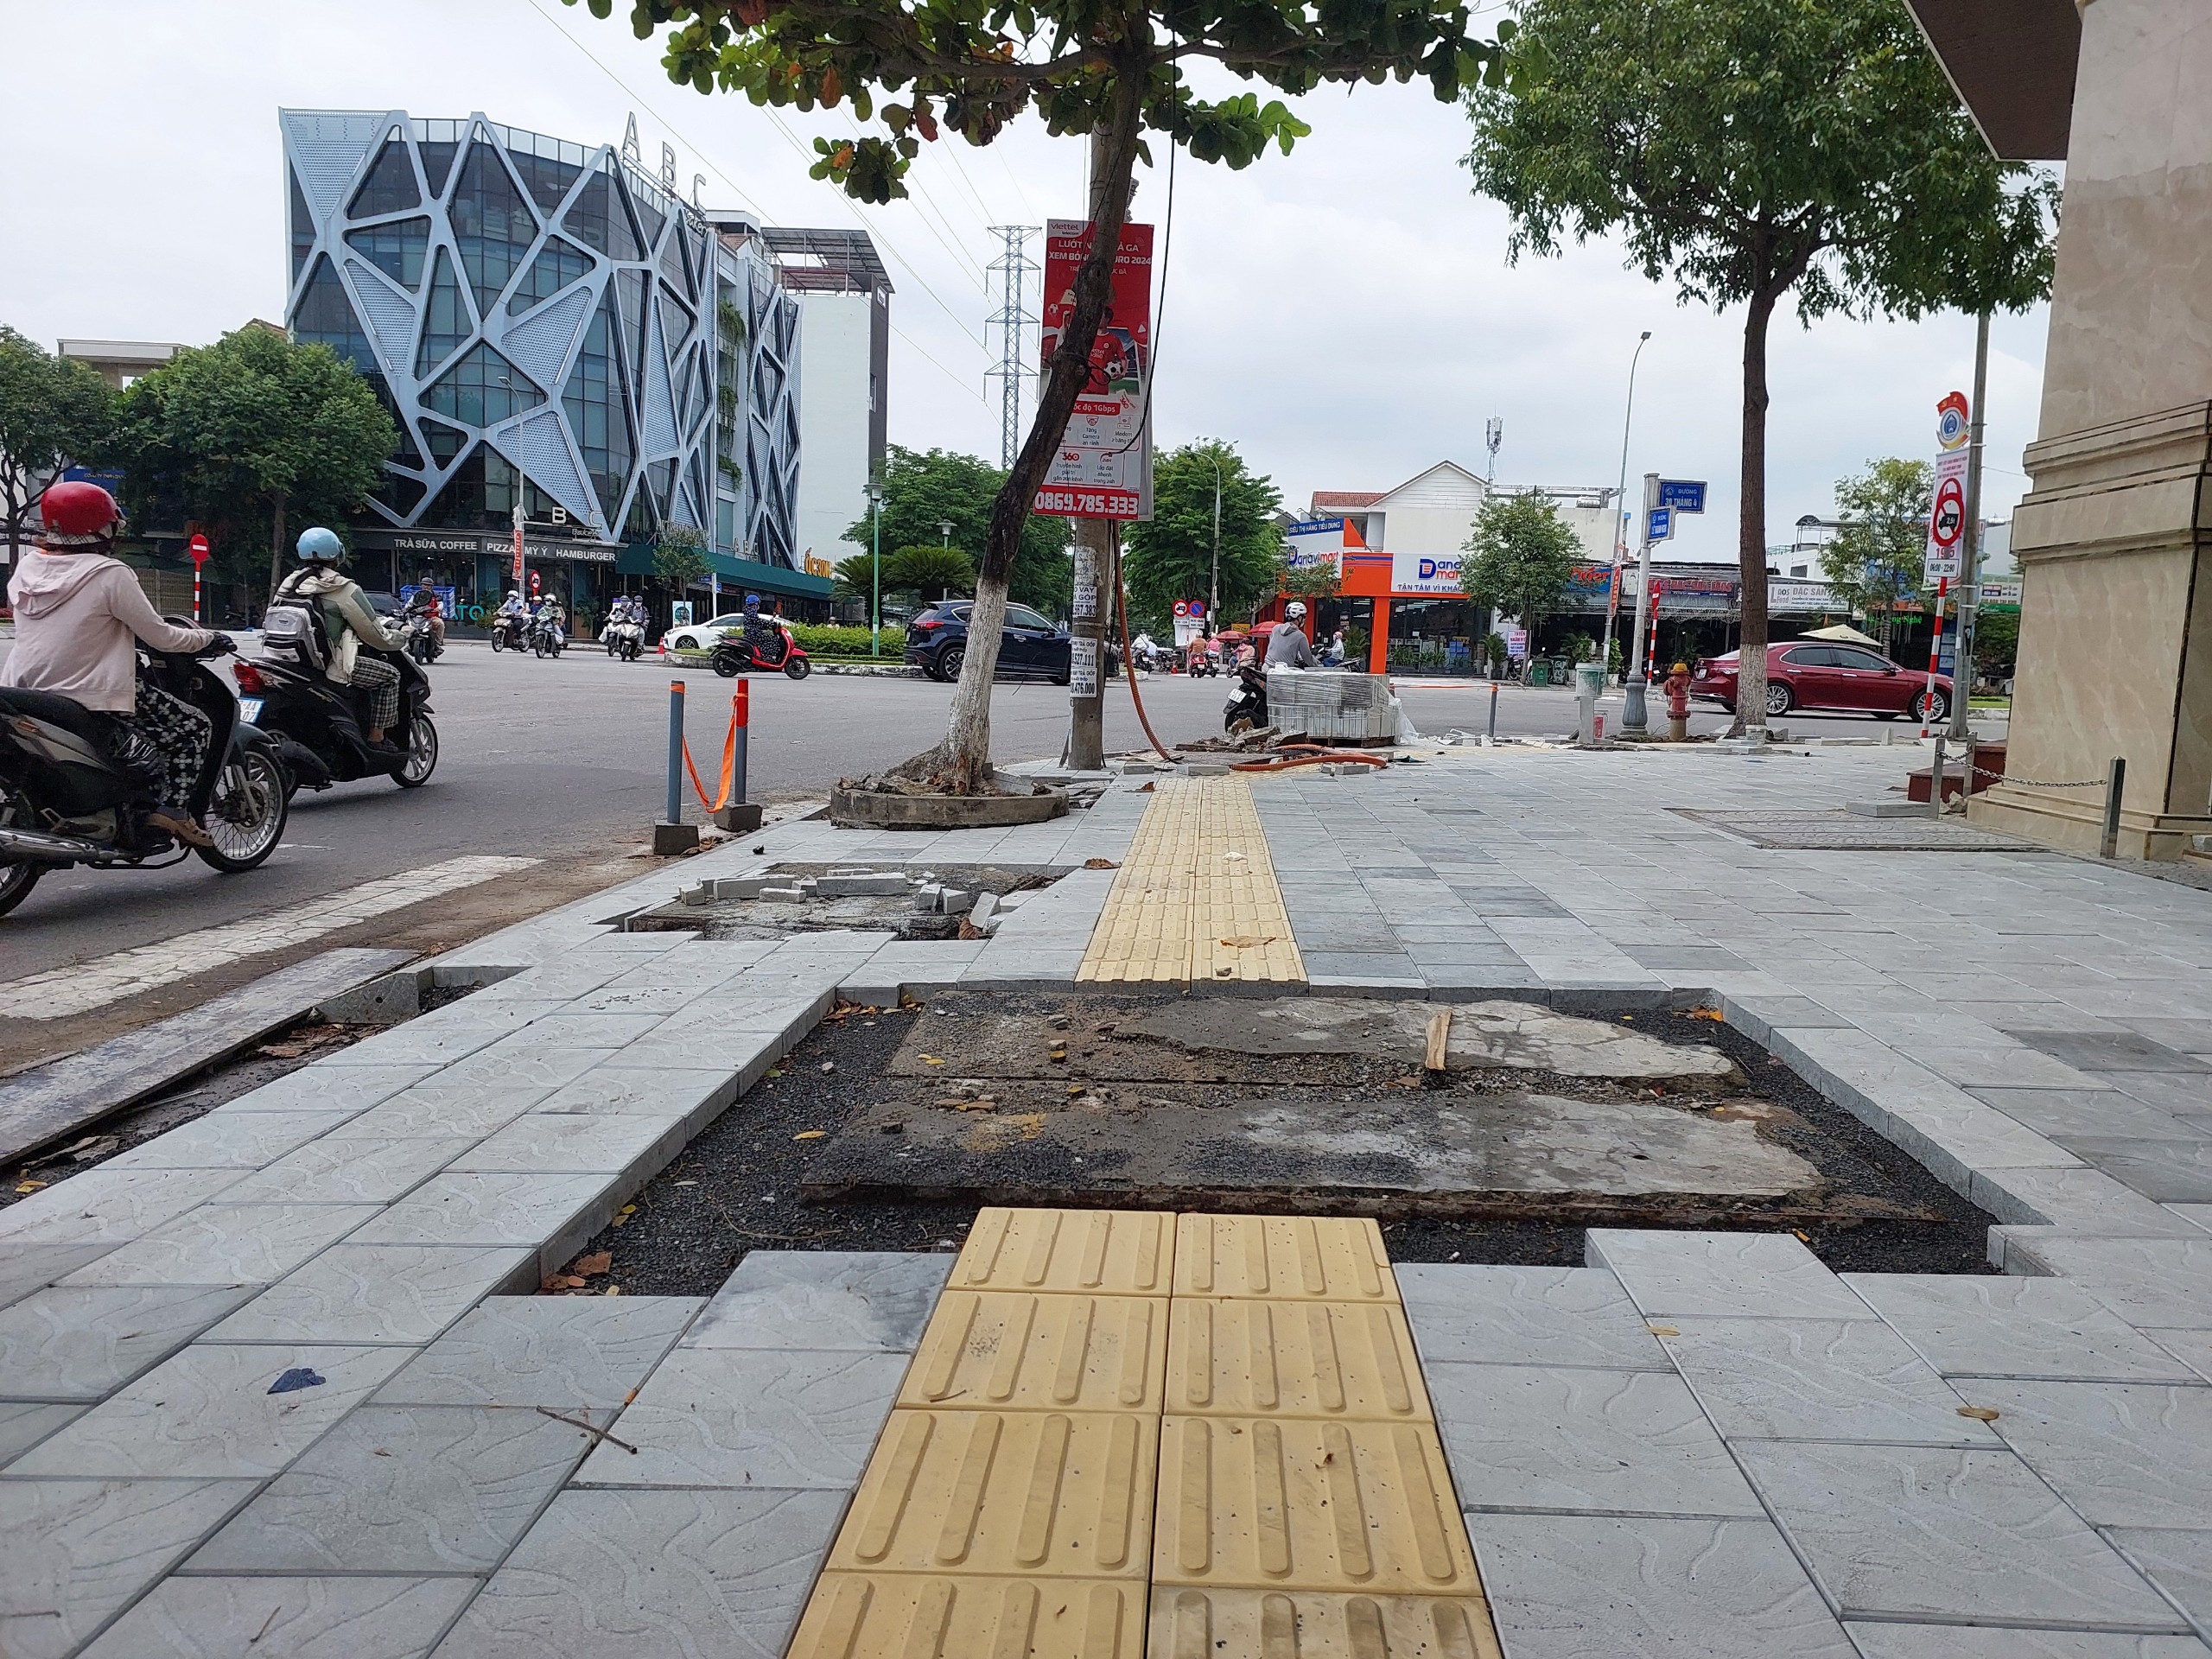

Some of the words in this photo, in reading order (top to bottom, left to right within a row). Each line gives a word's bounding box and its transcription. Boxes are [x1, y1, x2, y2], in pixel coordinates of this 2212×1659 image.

[1126, 244, 1139, 252] GA
[1048, 251, 1068, 260] XEM
[1131, 257, 1152, 265] 2024
[1094, 404, 1116, 413] 1Gbps
[1034, 491, 1138, 515] 0869.785.333
[1674, 496, 1692, 507] THÁNG
[1693, 498, 1697, 507] 4
[393, 537, 414, 549] TRÀ
[439, 540, 478, 550] COFFEE
[486, 543, 516, 554] PIZZA
[556, 548, 616, 562] HAMBURGER
